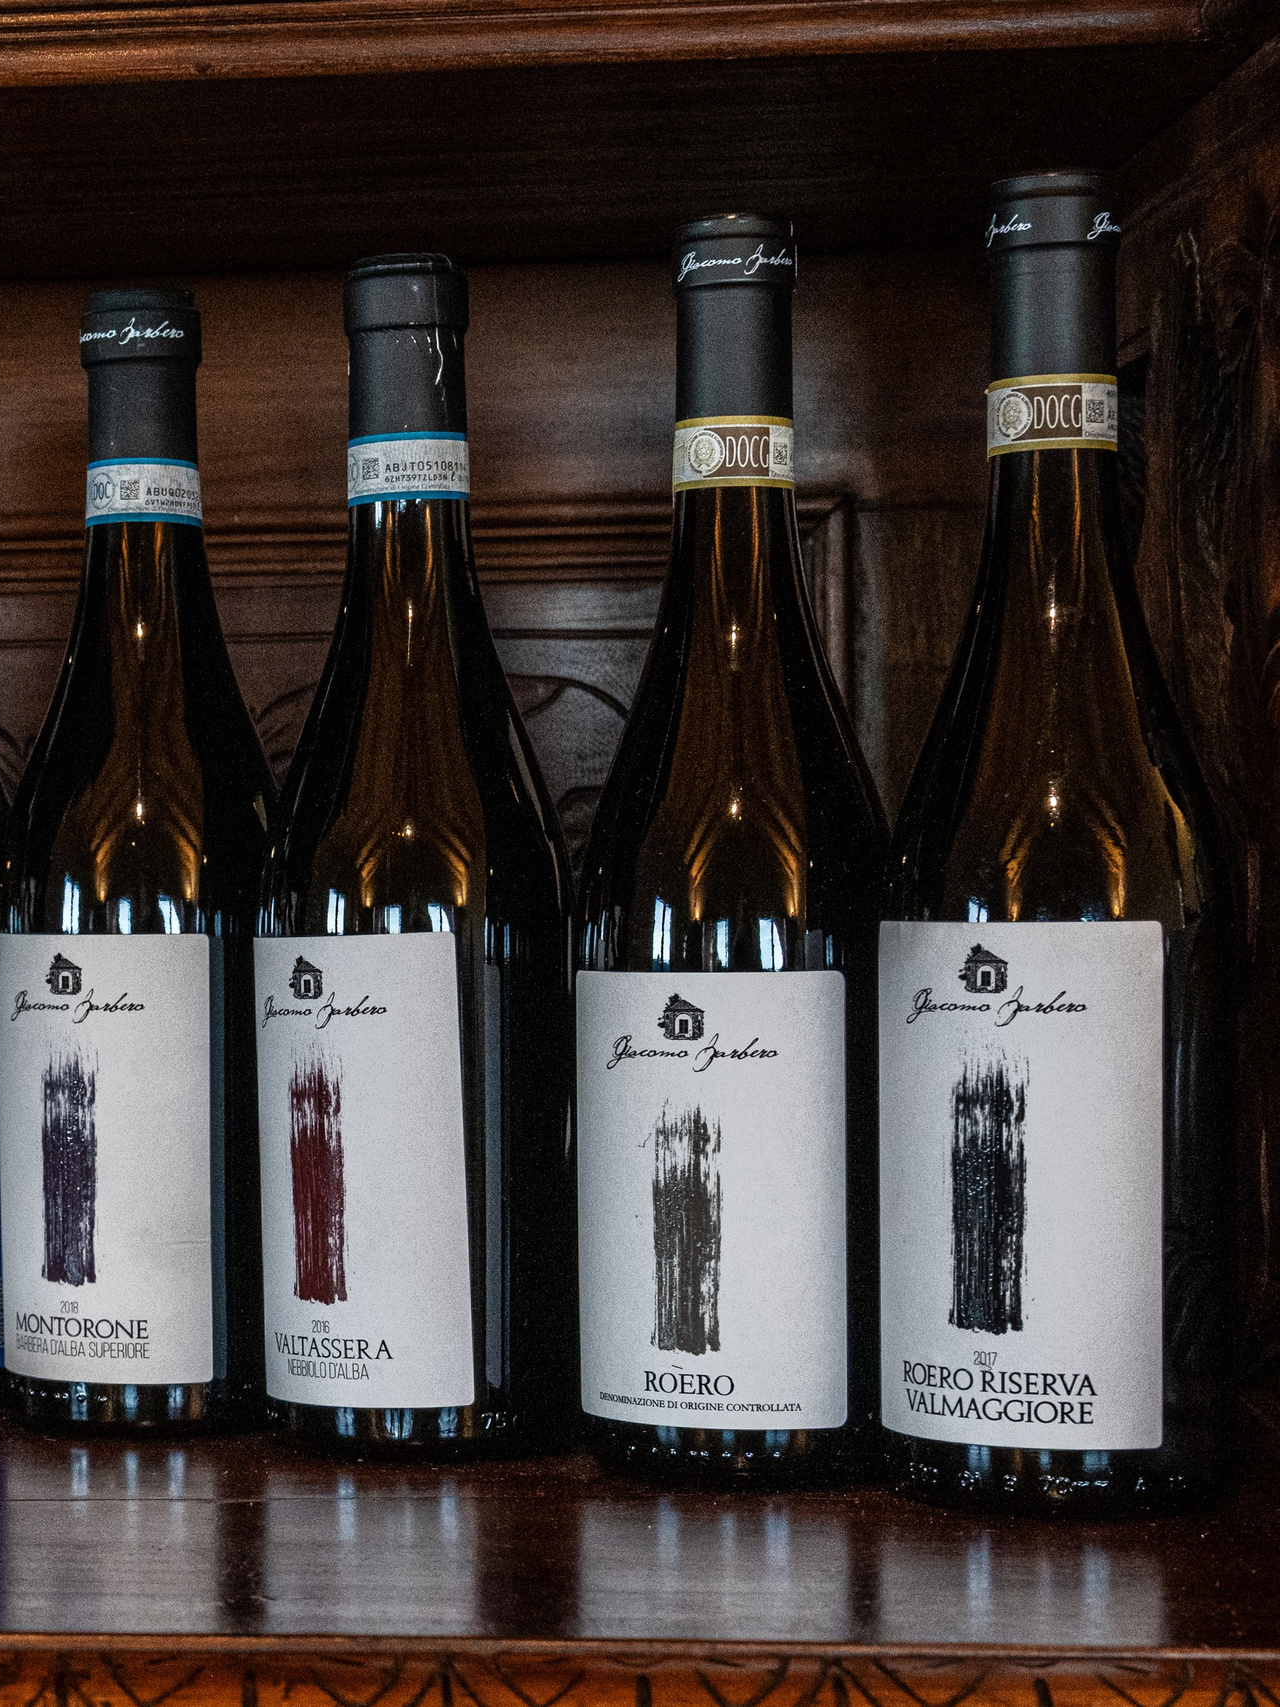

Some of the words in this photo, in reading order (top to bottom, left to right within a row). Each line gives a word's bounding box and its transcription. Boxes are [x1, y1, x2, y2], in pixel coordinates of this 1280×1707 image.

[676, 251, 741, 283] Giacomo
[118, 317, 185, 345] Barbero
[1033, 394, 1082, 430] DOCG
[725, 435, 770, 468] DOCG
[93, 481, 111, 501] DOC
[10, 989, 70, 1023] Giacomo
[73, 988, 146, 1024] Barbero
[261, 995, 313, 1028] Giacomo
[315, 990, 388, 1030] Barbero
[905, 988, 991, 1025] Giacomo
[994, 985, 1088, 1028] Barbero
[606, 1034, 689, 1070] Giacomo
[692, 1032, 779, 1073] Barbero
[59, 1300, 80, 1314] 2018
[15, 1311, 149, 1340] MONTORONE
[311, 1319, 331, 1335] 2016
[49, 1340, 86, 1358] D'ALBA
[88, 1341, 150, 1360] SUPERIORE
[274, 1331, 394, 1361] VALTASSERA
[973, 1350, 998, 1366] 2017
[287, 1357, 327, 1380] NEBBIOLO
[328, 1359, 370, 1381] D'ALBA
[643, 1369, 735, 1397] ROERO
[902, 1359, 974, 1392] ROERO
[979, 1368, 1098, 1398] RISERVA
[599, 1390, 665, 1409] DENOMINAZIONE
[667, 1400, 678, 1410] DI
[680, 1401, 724, 1412] ORIGINE
[726, 1402, 803, 1413] CONTROLLATA
[904, 1387, 1095, 1425] VALMAGGIORE
